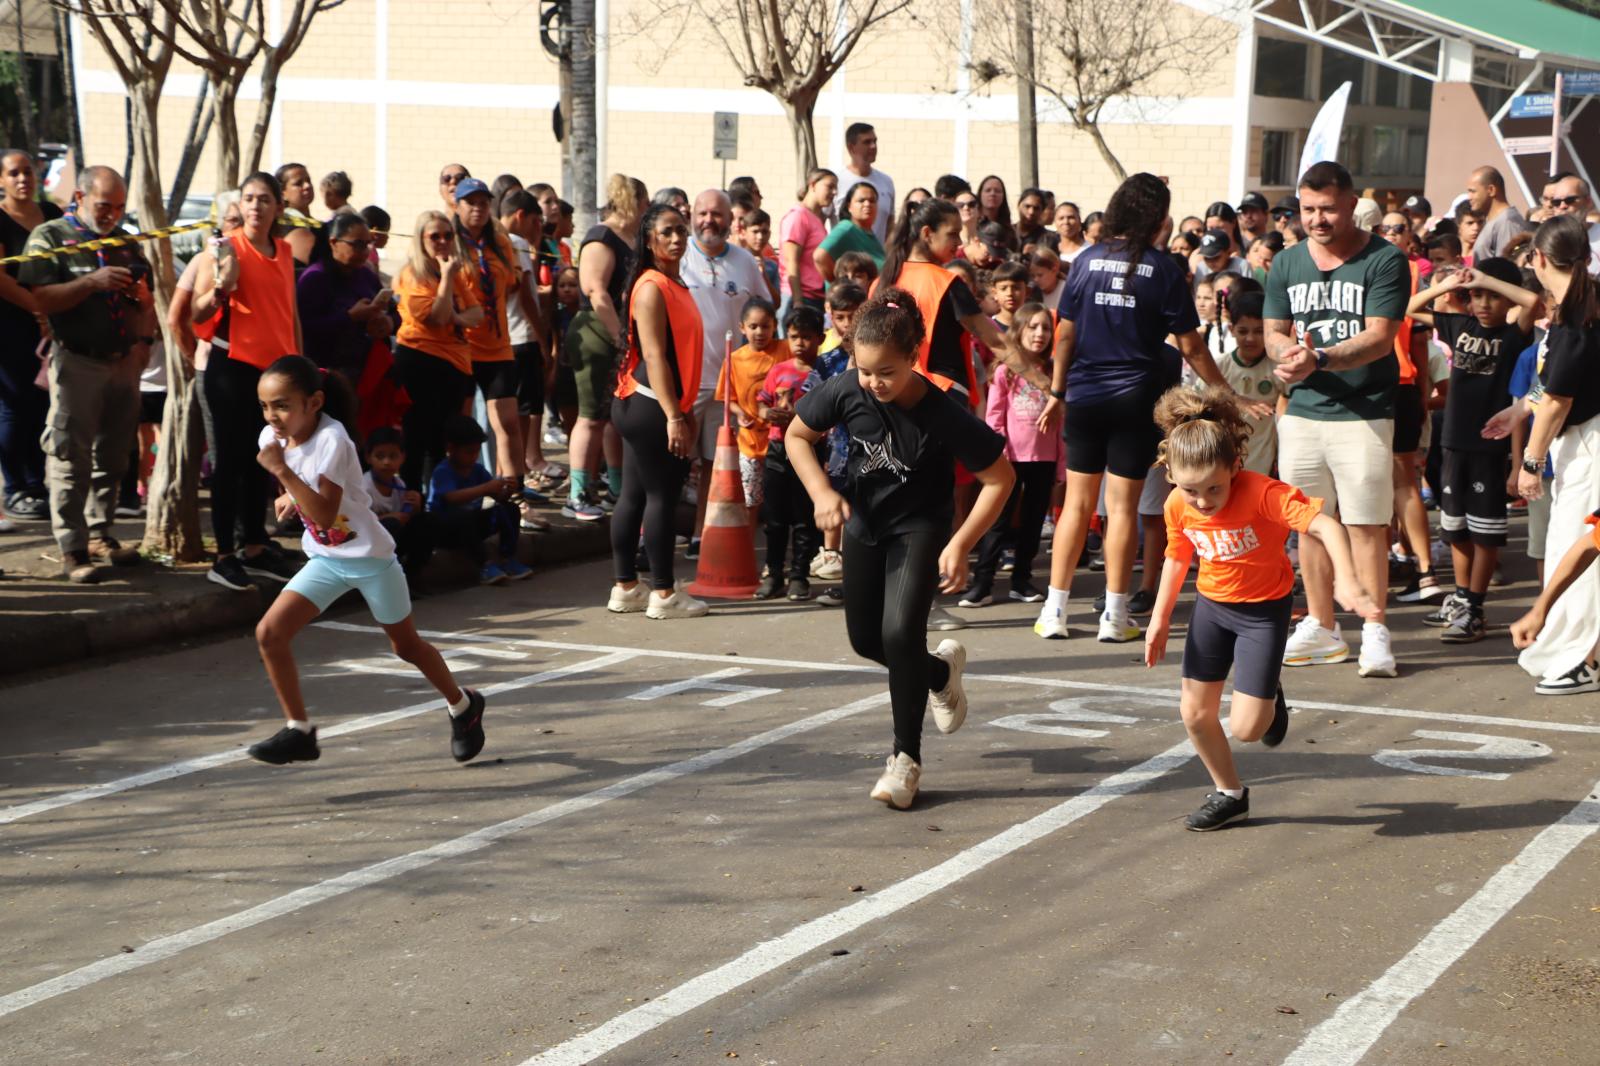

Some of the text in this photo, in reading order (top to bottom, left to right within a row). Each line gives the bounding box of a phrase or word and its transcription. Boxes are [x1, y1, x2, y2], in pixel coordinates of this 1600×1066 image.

[1111, 276, 1125, 290] DE
[1287, 280, 1365, 315] TRAXART
[1337, 320, 1361, 339] 90
[1456, 332, 1503, 356] POINT
[1216, 532, 1259, 555] RUN
